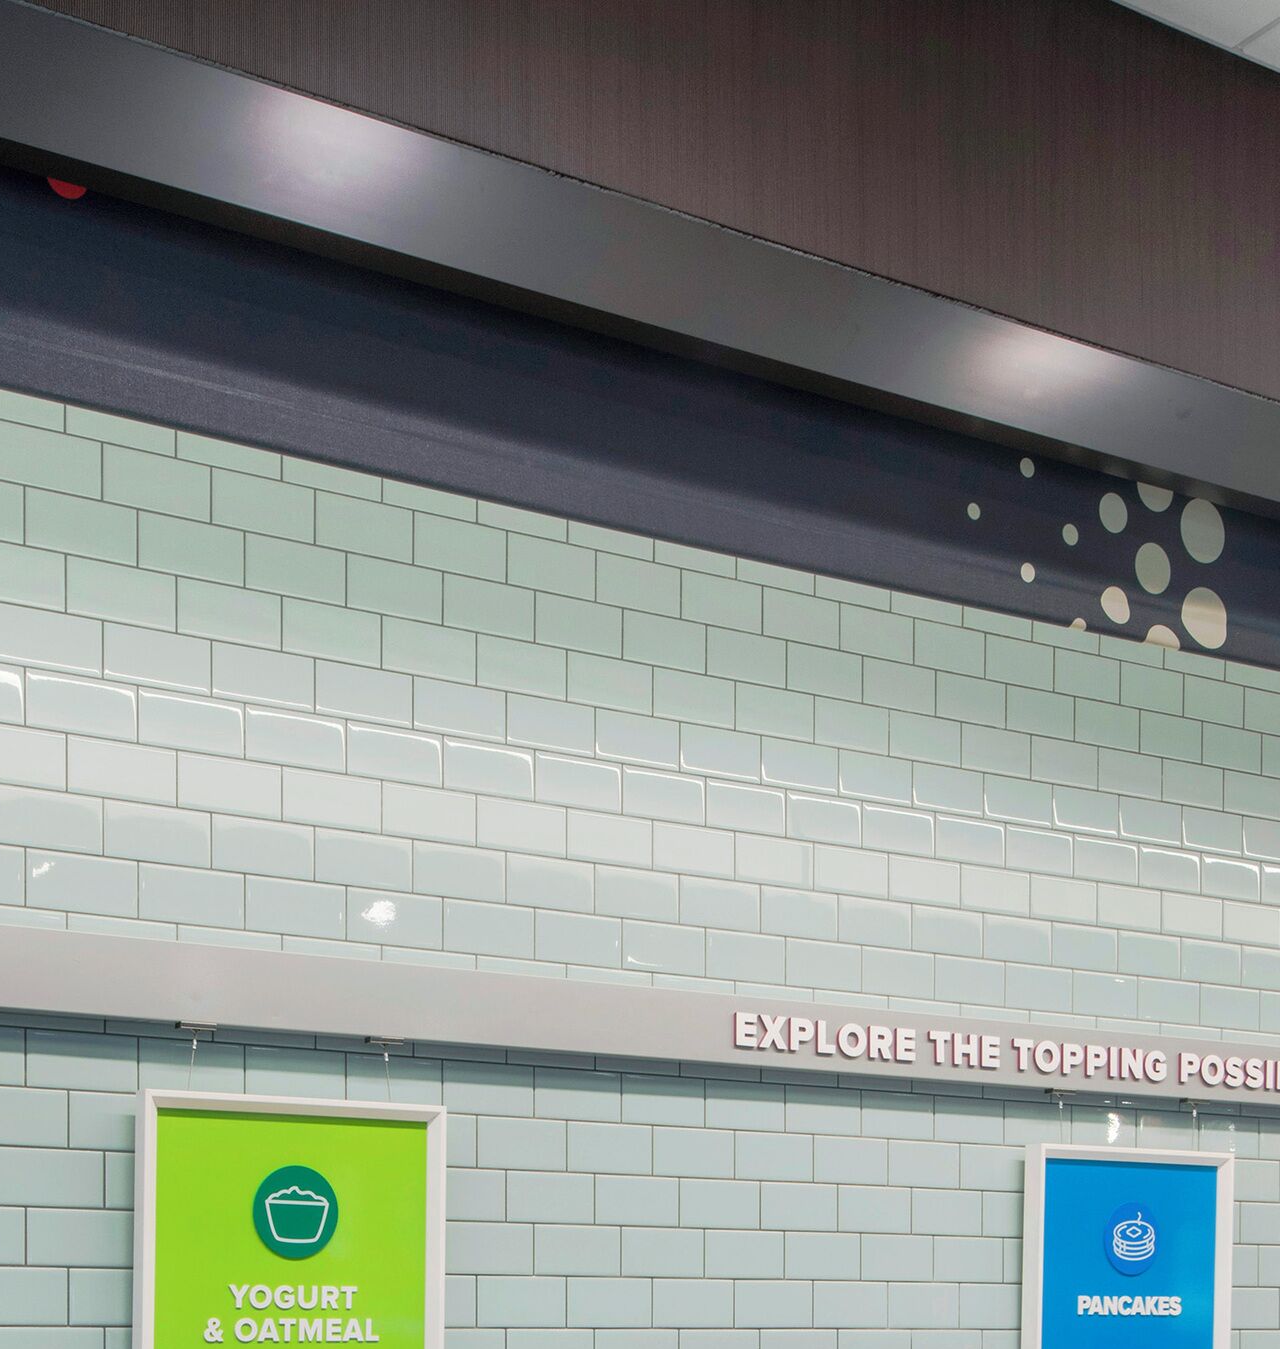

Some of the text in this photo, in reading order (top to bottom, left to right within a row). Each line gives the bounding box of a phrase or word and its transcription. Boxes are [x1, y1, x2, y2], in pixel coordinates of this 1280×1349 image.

[734, 1011, 916, 1061] EXPLORE
[928, 1029, 1000, 1068] THE
[1012, 1037, 1168, 1082] TOPPING
[228, 1284, 358, 1310] YOGURT
[1077, 1295, 1182, 1316] PANCAKES
[203, 1317, 380, 1343] & OATMEAL
